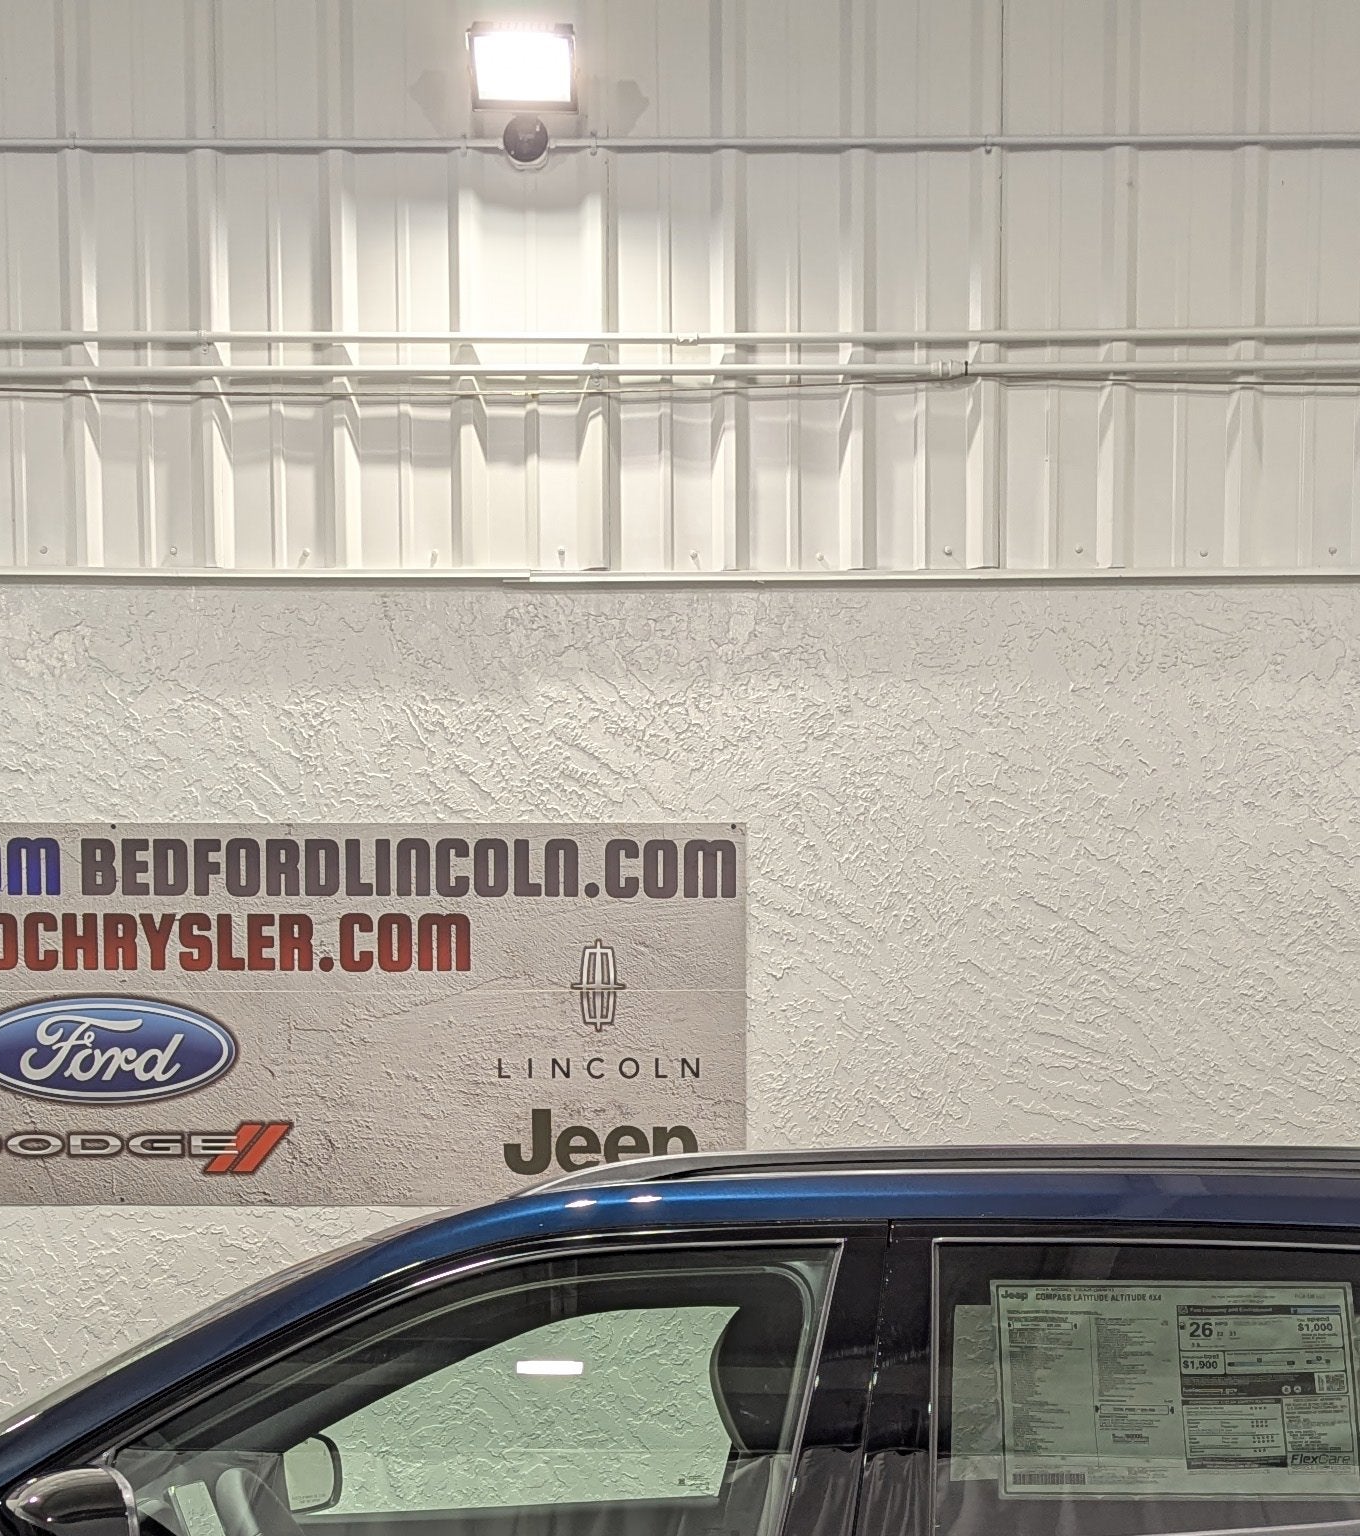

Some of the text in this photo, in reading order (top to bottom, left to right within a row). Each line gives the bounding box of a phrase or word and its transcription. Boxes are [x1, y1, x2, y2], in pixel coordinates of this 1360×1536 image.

[80, 837, 737, 899] BEDFORDLINCOLN.COM
[19, 1014, 185, 1082] Ford
[497, 1057, 700, 1079] LINCOLN
[1001, 1290, 1028, 1301] Jeep
[1035, 1293, 1072, 1301] COMPASS
[1073, 1293, 1109, 1302] LATITUDE
[1110, 1294, 1147, 1302] ALTITUDE
[1189, 1321, 1214, 1338] 26
[1297, 1323, 1333, 1333] $1,000
[1291, 1453, 1351, 1465] FlexCare
